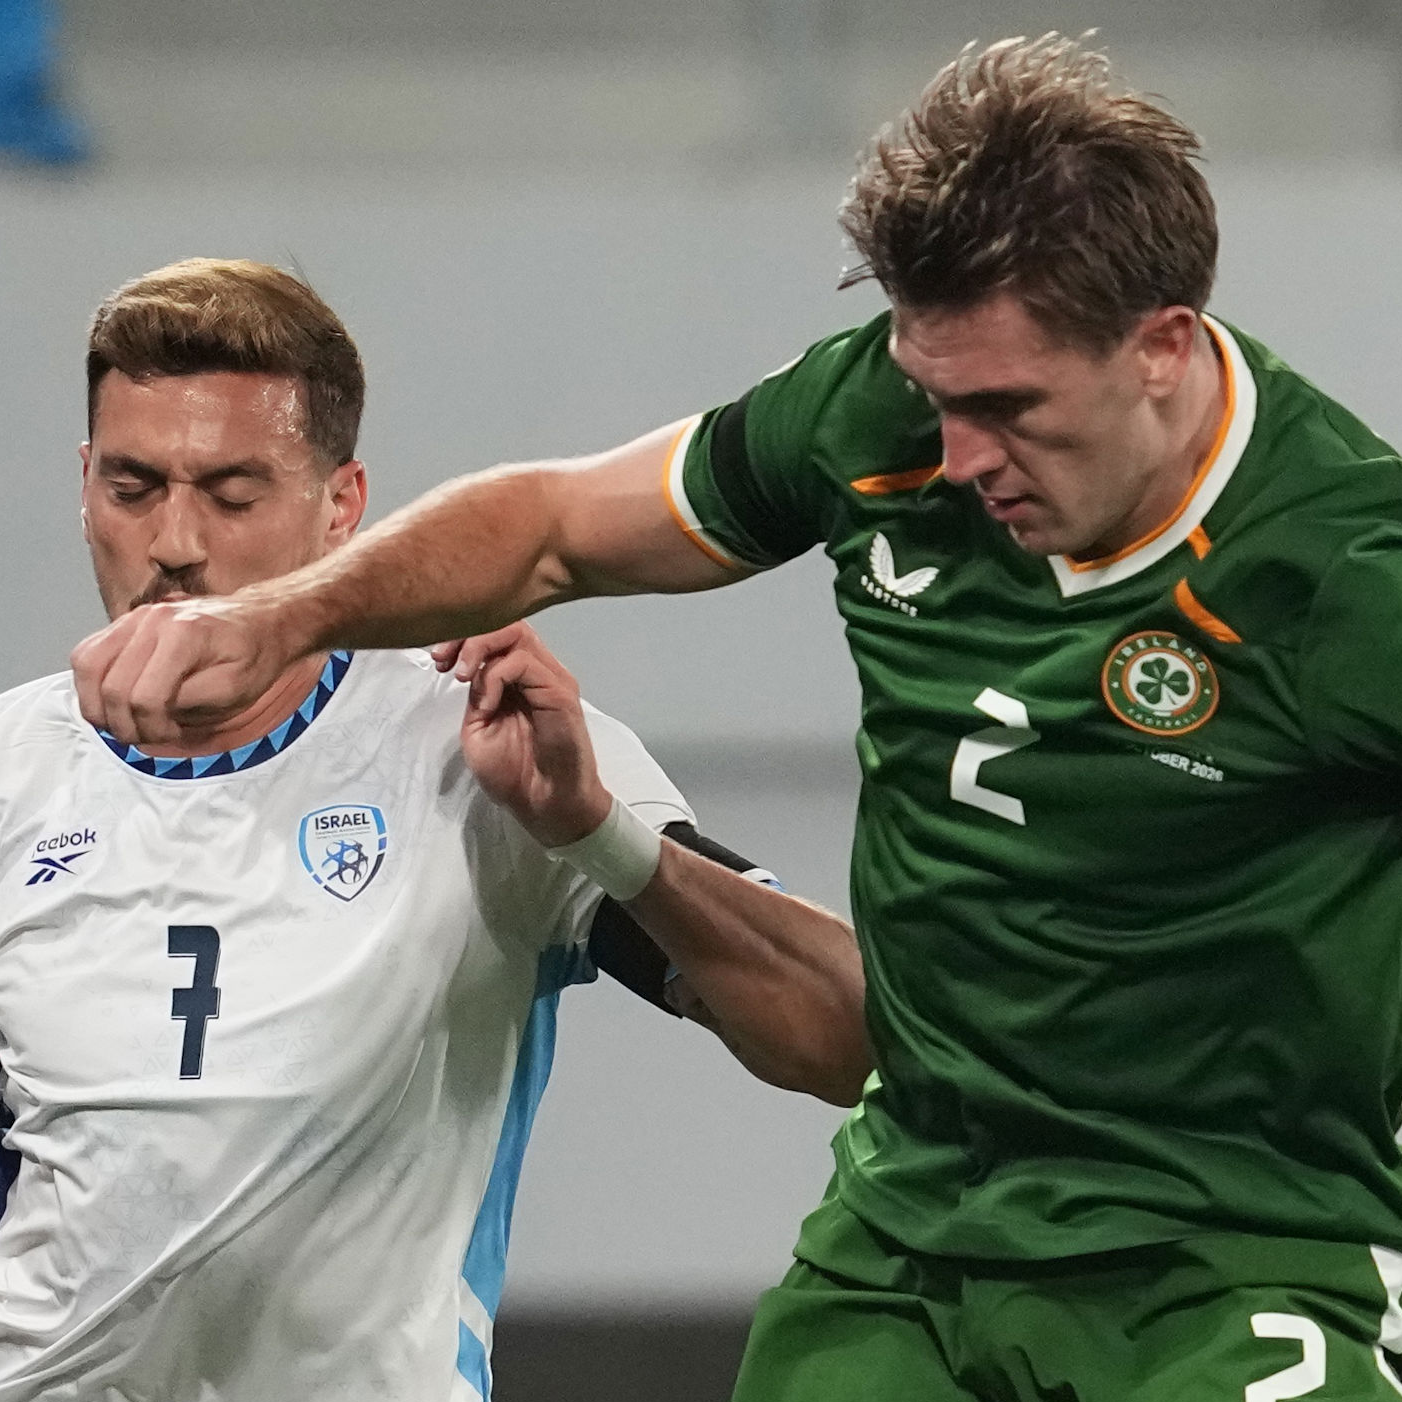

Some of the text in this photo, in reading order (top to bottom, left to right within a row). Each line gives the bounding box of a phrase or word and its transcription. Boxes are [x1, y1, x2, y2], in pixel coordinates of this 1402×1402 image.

[314, 812, 370, 830] ISRAEL
[950, 687, 1040, 827] 2
[168, 925, 221, 1080] 7
